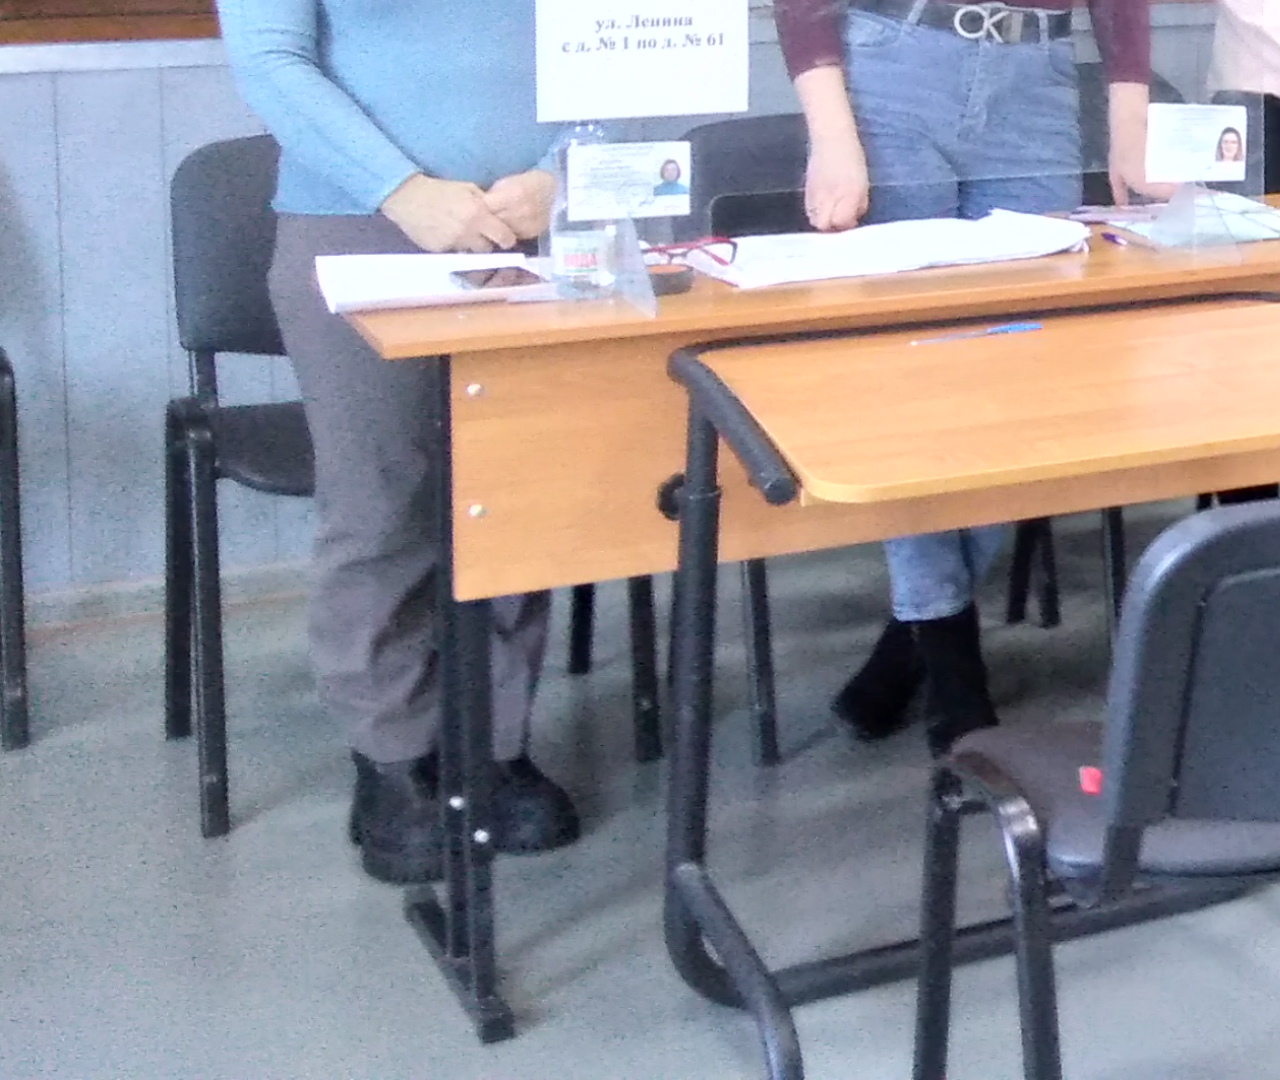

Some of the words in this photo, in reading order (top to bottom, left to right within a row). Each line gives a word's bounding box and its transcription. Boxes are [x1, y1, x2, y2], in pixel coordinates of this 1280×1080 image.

[594, 18, 621, 33] ул.
[626, 15, 693, 29] Ленина
[596, 36, 616, 51] №
[623, 36, 629, 50] 1
[637, 38, 657, 50] по
[682, 33, 702, 48] №
[707, 32, 724, 46] 61
